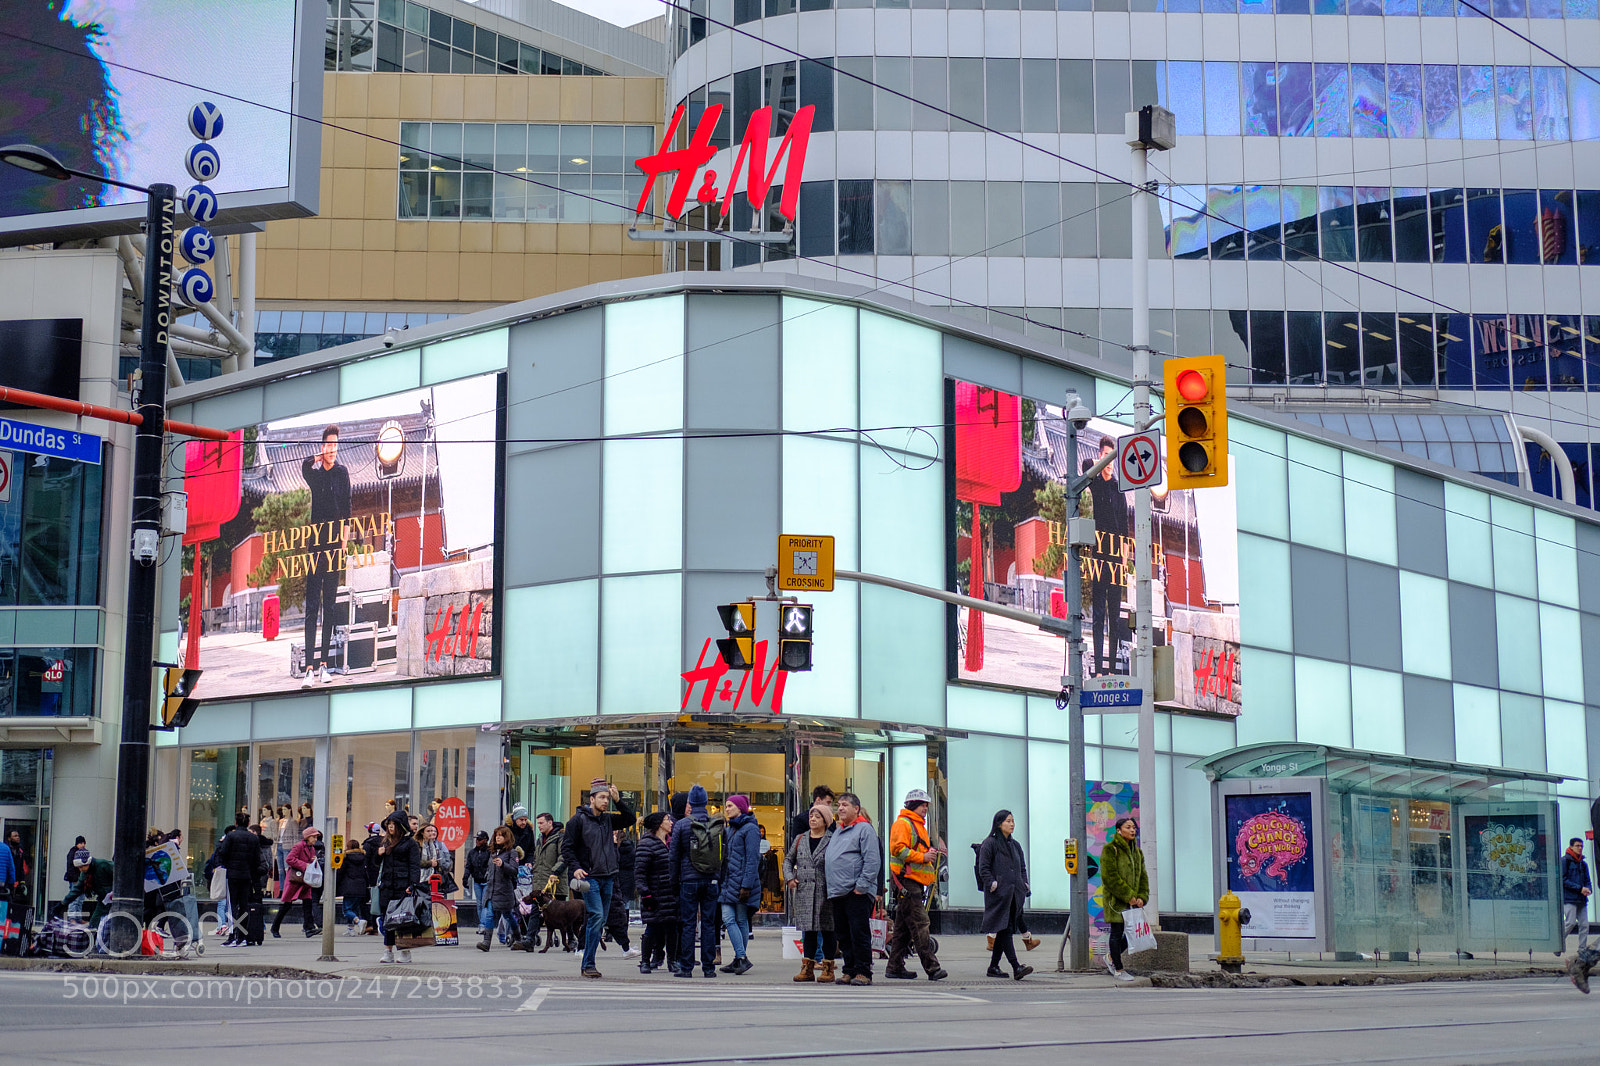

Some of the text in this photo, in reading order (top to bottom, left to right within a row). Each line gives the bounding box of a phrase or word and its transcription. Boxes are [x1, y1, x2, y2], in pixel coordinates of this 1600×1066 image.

[634, 103, 816, 221] H&M
[183, 101, 222, 304] Yonge
[156, 197, 175, 346] DOWNTOWN
[0, 420, 82, 450] Dundas St
[262, 511, 394, 555] HAPPY LUNAR
[788, 538, 823, 548] PRIORITY
[276, 543, 376, 580] NEW YEAR
[786, 577, 825, 588] CROSSING
[425, 601, 484, 663] H&M
[45, 671, 63, 680] QLO
[680, 637, 789, 715] H&M
[1194, 648, 1235, 702] H&M
[1092, 692, 1130, 706] Yonge St
[1261, 762, 1299, 772] Yonge St
[438, 805, 466, 819] SALE
[440, 826, 464, 842] 70%
[1250, 822, 1269, 834] YOU
[1248, 830, 1298, 848] CHANGE
[1257, 844, 1301, 855] THE WORLD
